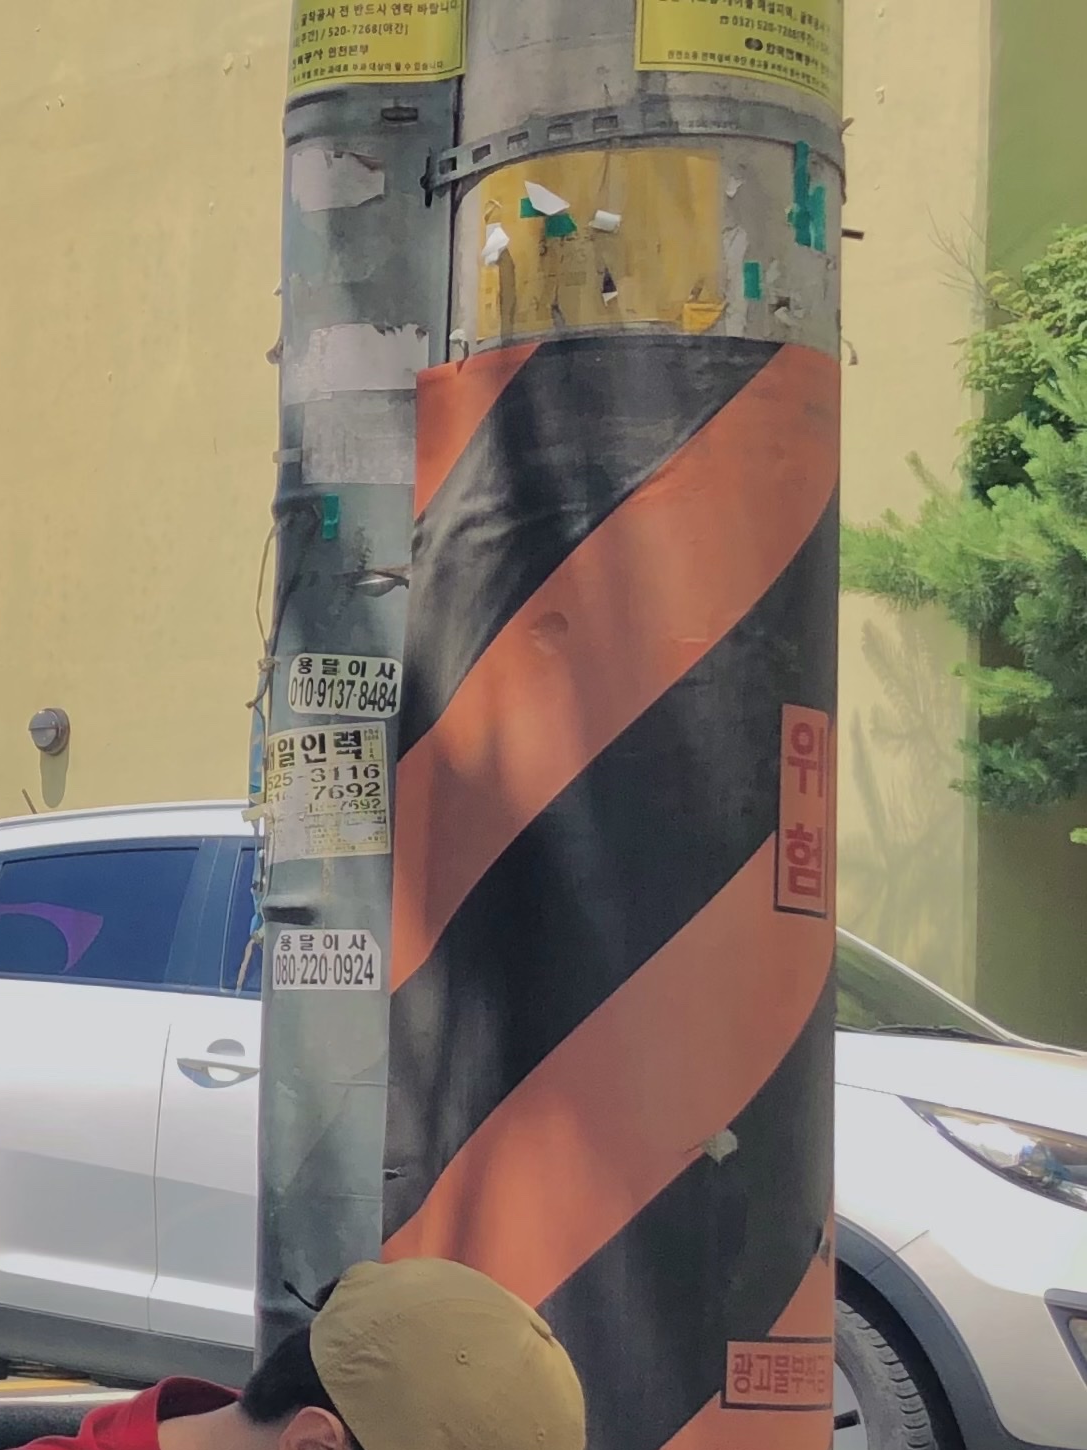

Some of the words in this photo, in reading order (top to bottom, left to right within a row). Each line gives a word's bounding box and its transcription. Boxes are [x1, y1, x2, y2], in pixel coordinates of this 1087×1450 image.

[354, 3, 387, 16] 반드시
[392, 3, 413, 16] 연락
[417, 0, 459, 15] 바랍니다
[298, 656, 396, 680] 용달이사
[784, 722, 824, 898] 위험
[280, 934, 367, 951] 용달이사
[275, 953, 374, 985] 080-220-0924
